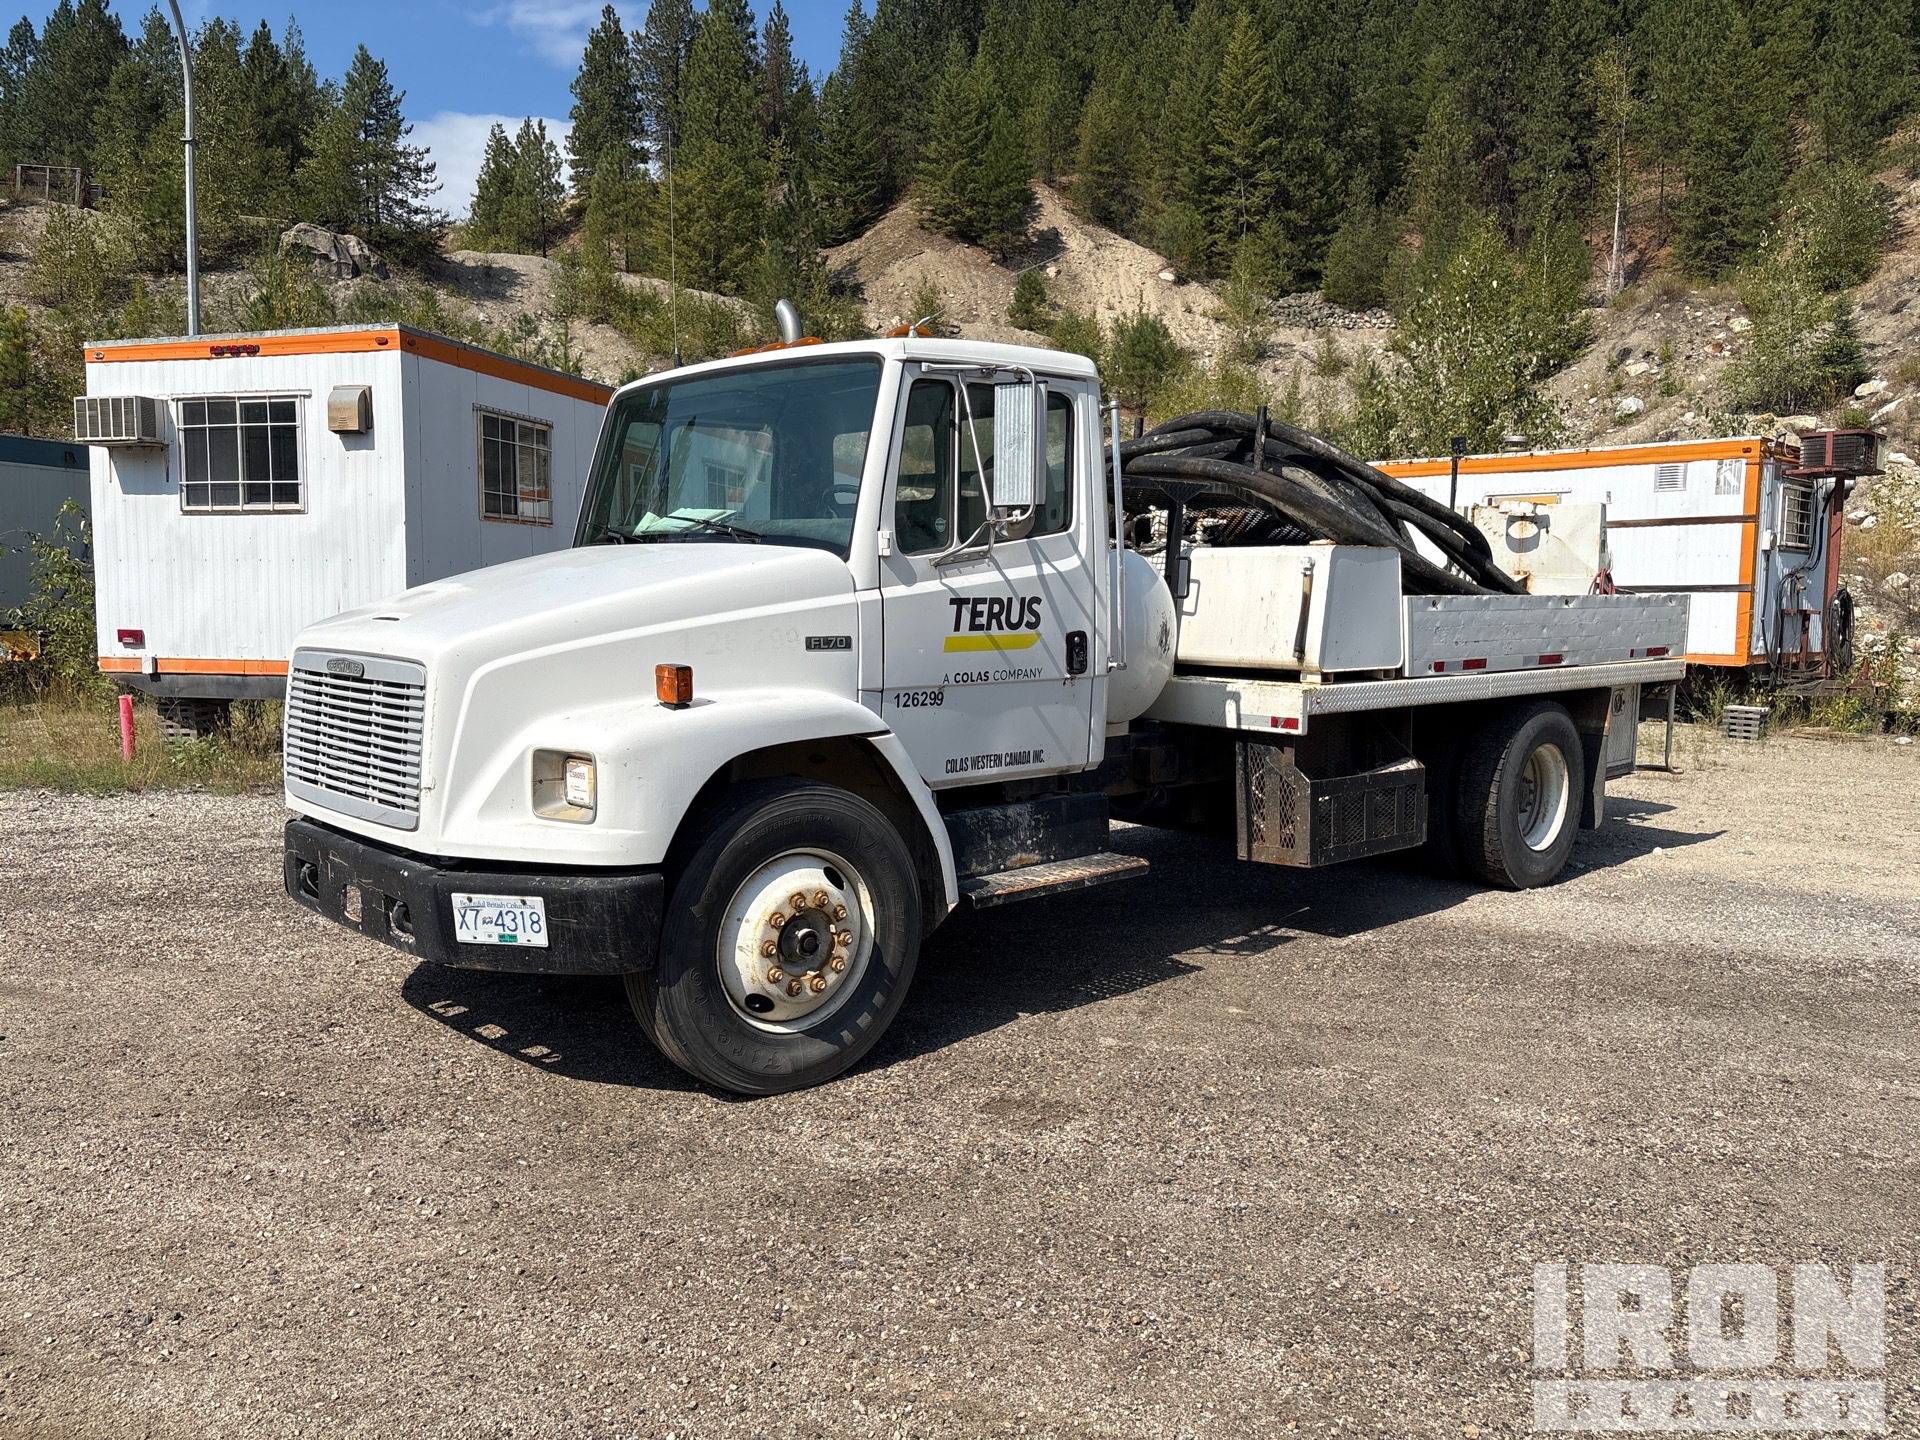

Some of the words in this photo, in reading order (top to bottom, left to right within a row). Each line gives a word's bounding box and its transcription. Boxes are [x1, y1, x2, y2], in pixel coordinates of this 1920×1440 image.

[949, 596, 1042, 632] TERUS
[811, 637, 846, 649] FL70
[942, 673, 950, 685] A
[954, 671, 989, 684] COLAS
[993, 667, 1043, 682] COMPANY
[894, 691, 944, 708] 126299
[945, 758, 969, 774] COLAS
[970, 754, 1003, 771] WESTERN
[1004, 751, 1031, 769] CANADA
[1032, 749, 1045, 764] INC.
[486, 901, 506, 909] British
[457, 908, 480, 931] X7
[494, 910, 542, 934] 4318
